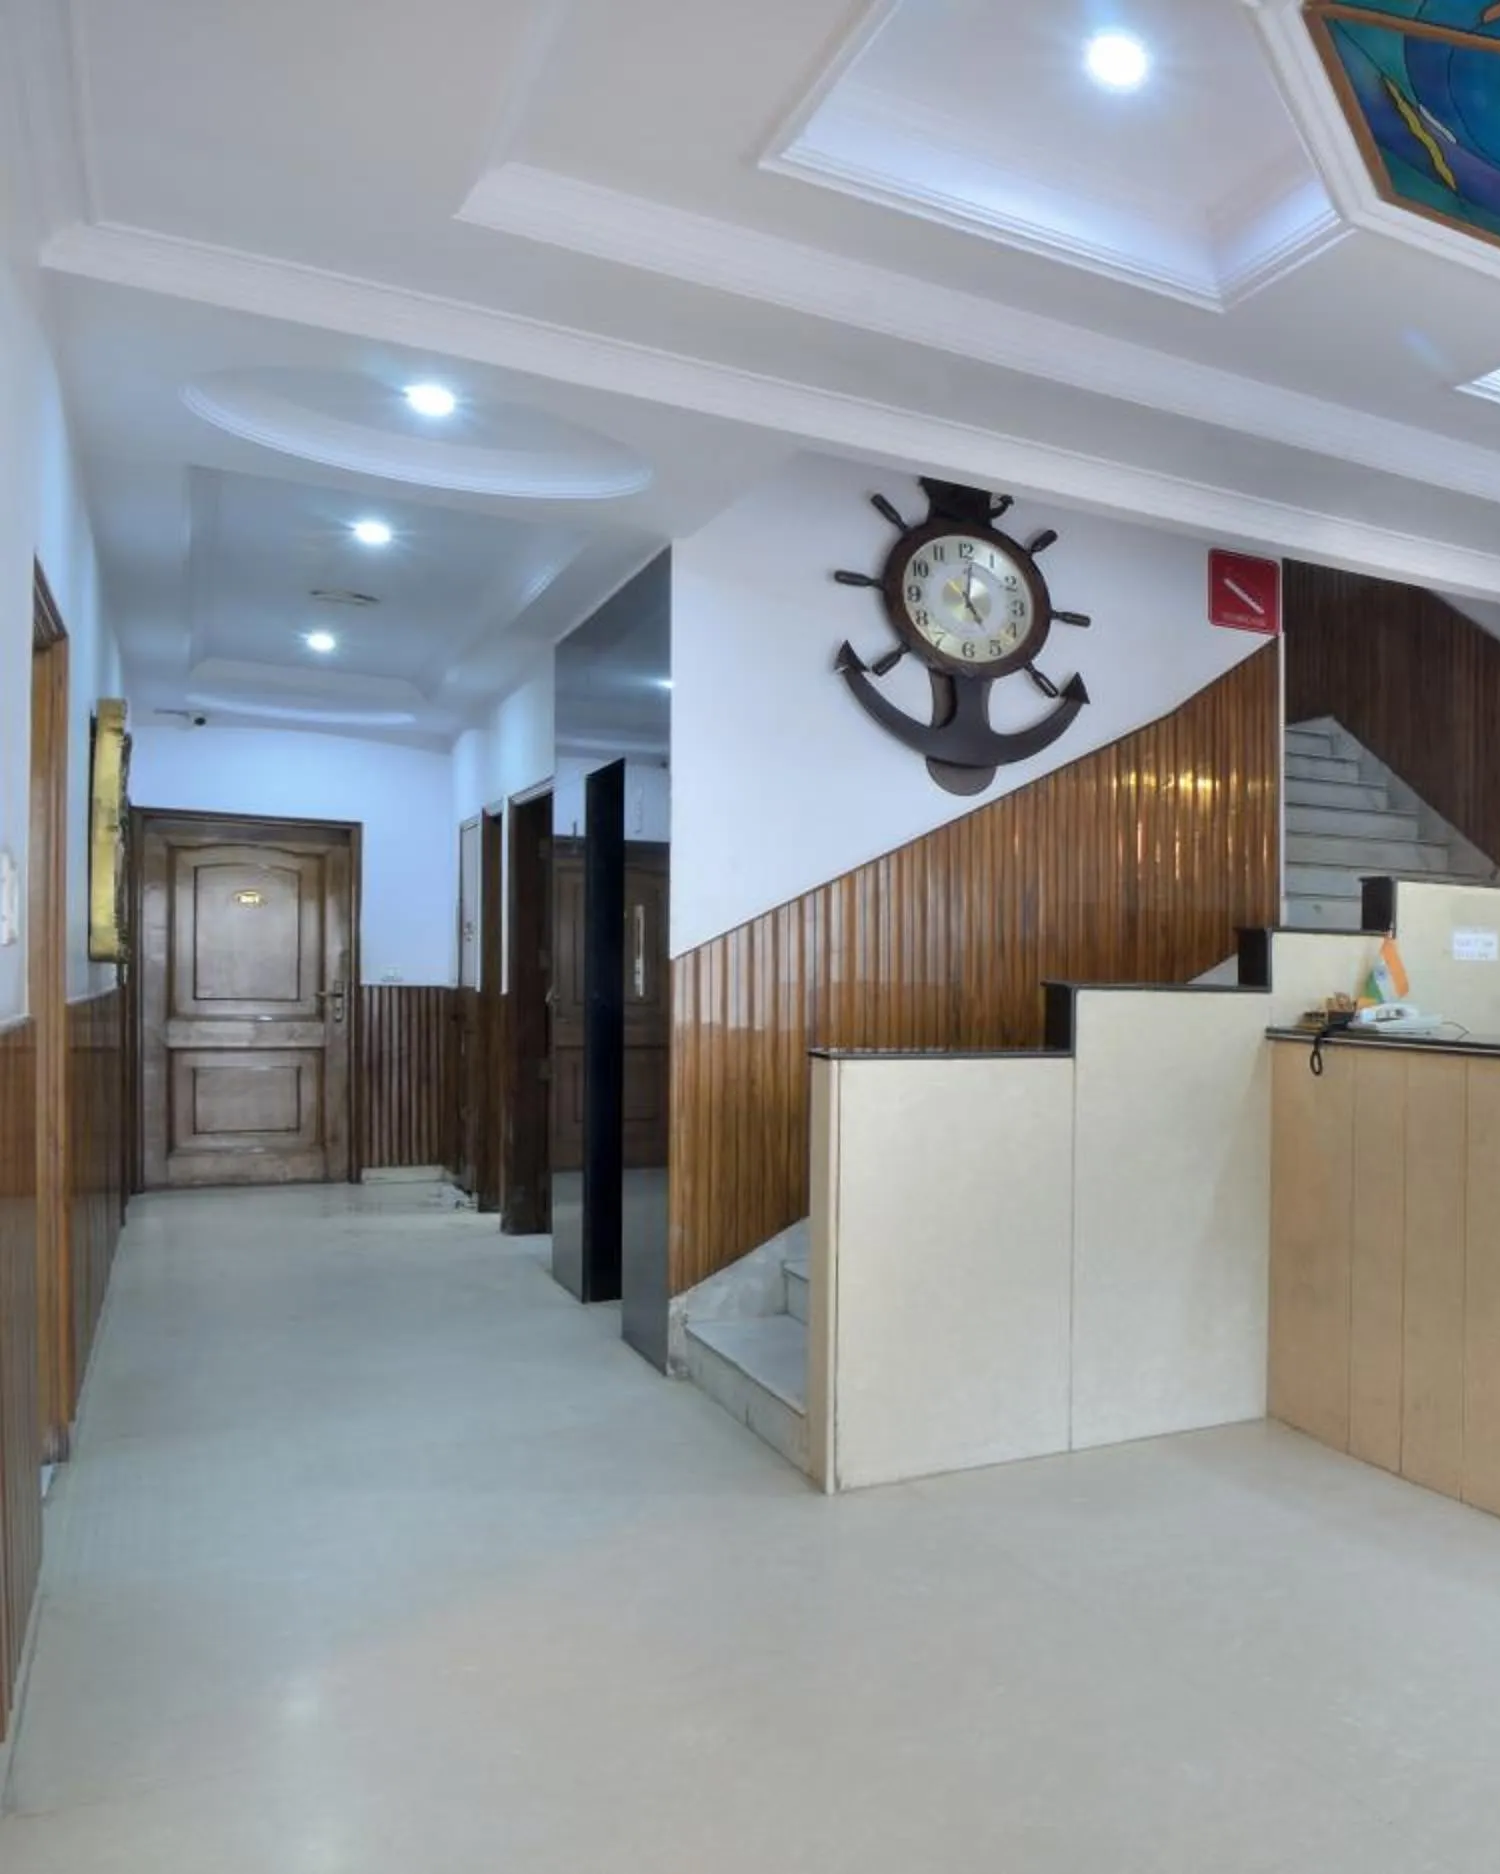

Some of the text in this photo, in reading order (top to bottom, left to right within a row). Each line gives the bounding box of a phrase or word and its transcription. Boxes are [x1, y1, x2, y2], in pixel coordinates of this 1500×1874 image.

[933, 544, 944, 561] 11
[958, 542, 974, 561] 12
[912, 560, 929, 578] 10
[1004, 575, 1017, 592] 2
[907, 585, 921, 602] 9
[1010, 600, 1025, 617] 3
[916, 610, 929, 627] 8
[934, 630, 945, 648] 7
[1005, 622, 1017, 639] 4
[961, 641, 975, 658] 6
[989, 639, 1002, 657] 5
